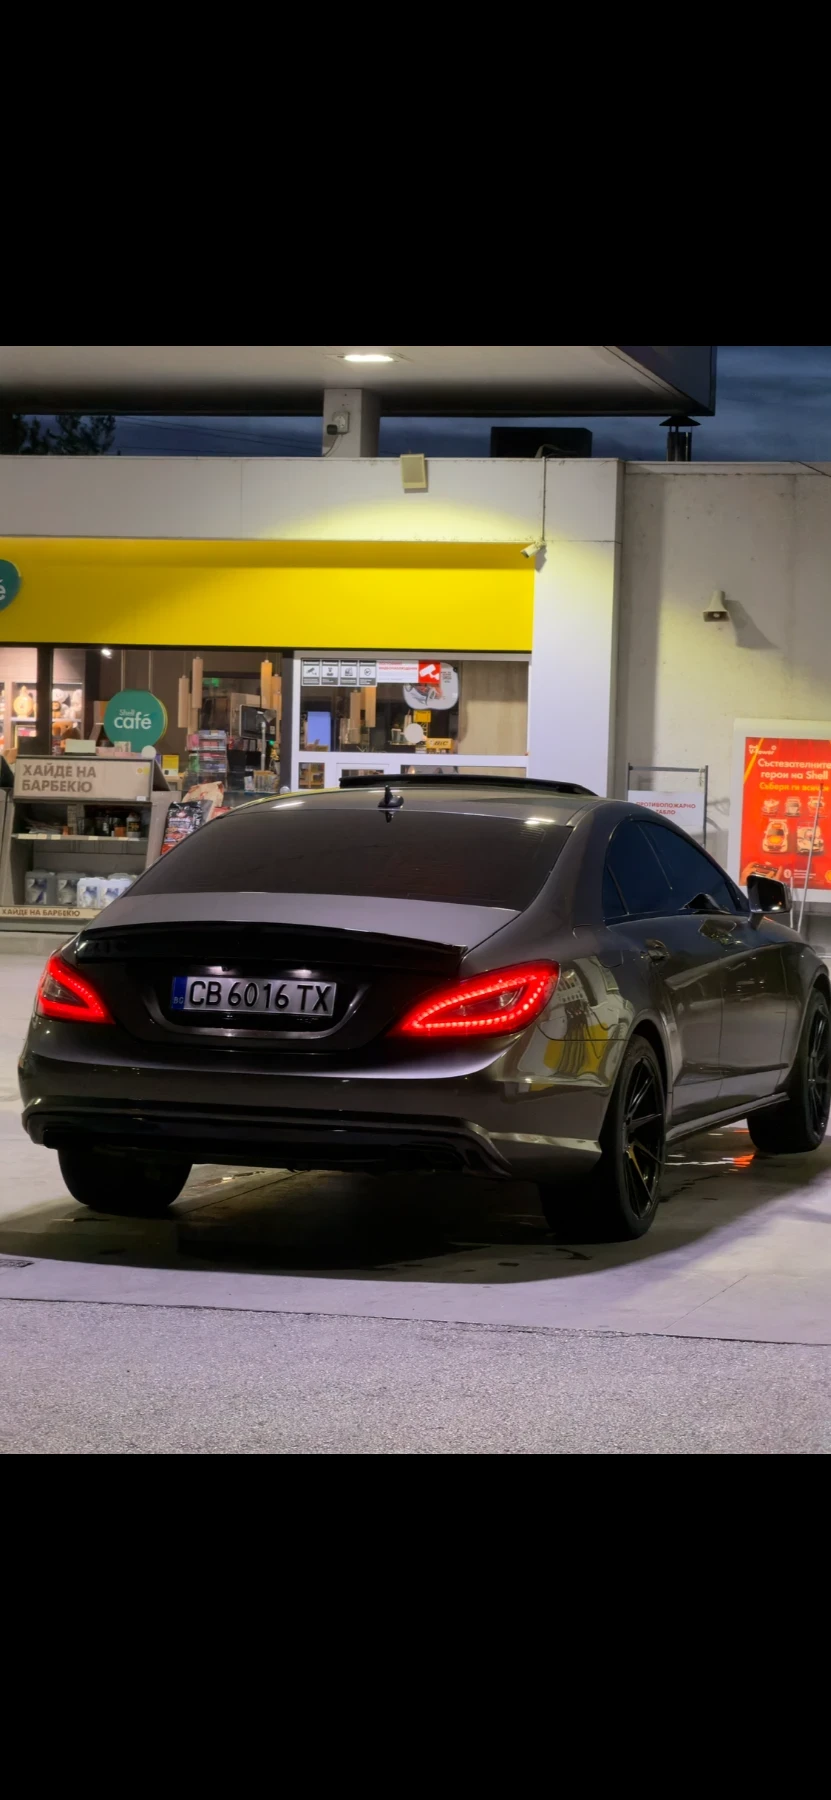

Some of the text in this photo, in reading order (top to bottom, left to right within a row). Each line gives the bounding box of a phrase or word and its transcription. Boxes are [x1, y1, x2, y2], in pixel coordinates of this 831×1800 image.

[113, 711, 152, 730] café
[22, 763, 97, 779] ХАЙДЕ НА
[760, 770, 829, 781] герои на Shell
[21, 779, 93, 793] БАРБЕКЮ
[636, 801, 696, 809] ПРОТИВОПОЖАРНО
[2, 908, 28, 916] ХАЙДЕ
[42, 909, 80, 917] БАРБЕКЮ
[227, 981, 290, 1010] 6016
